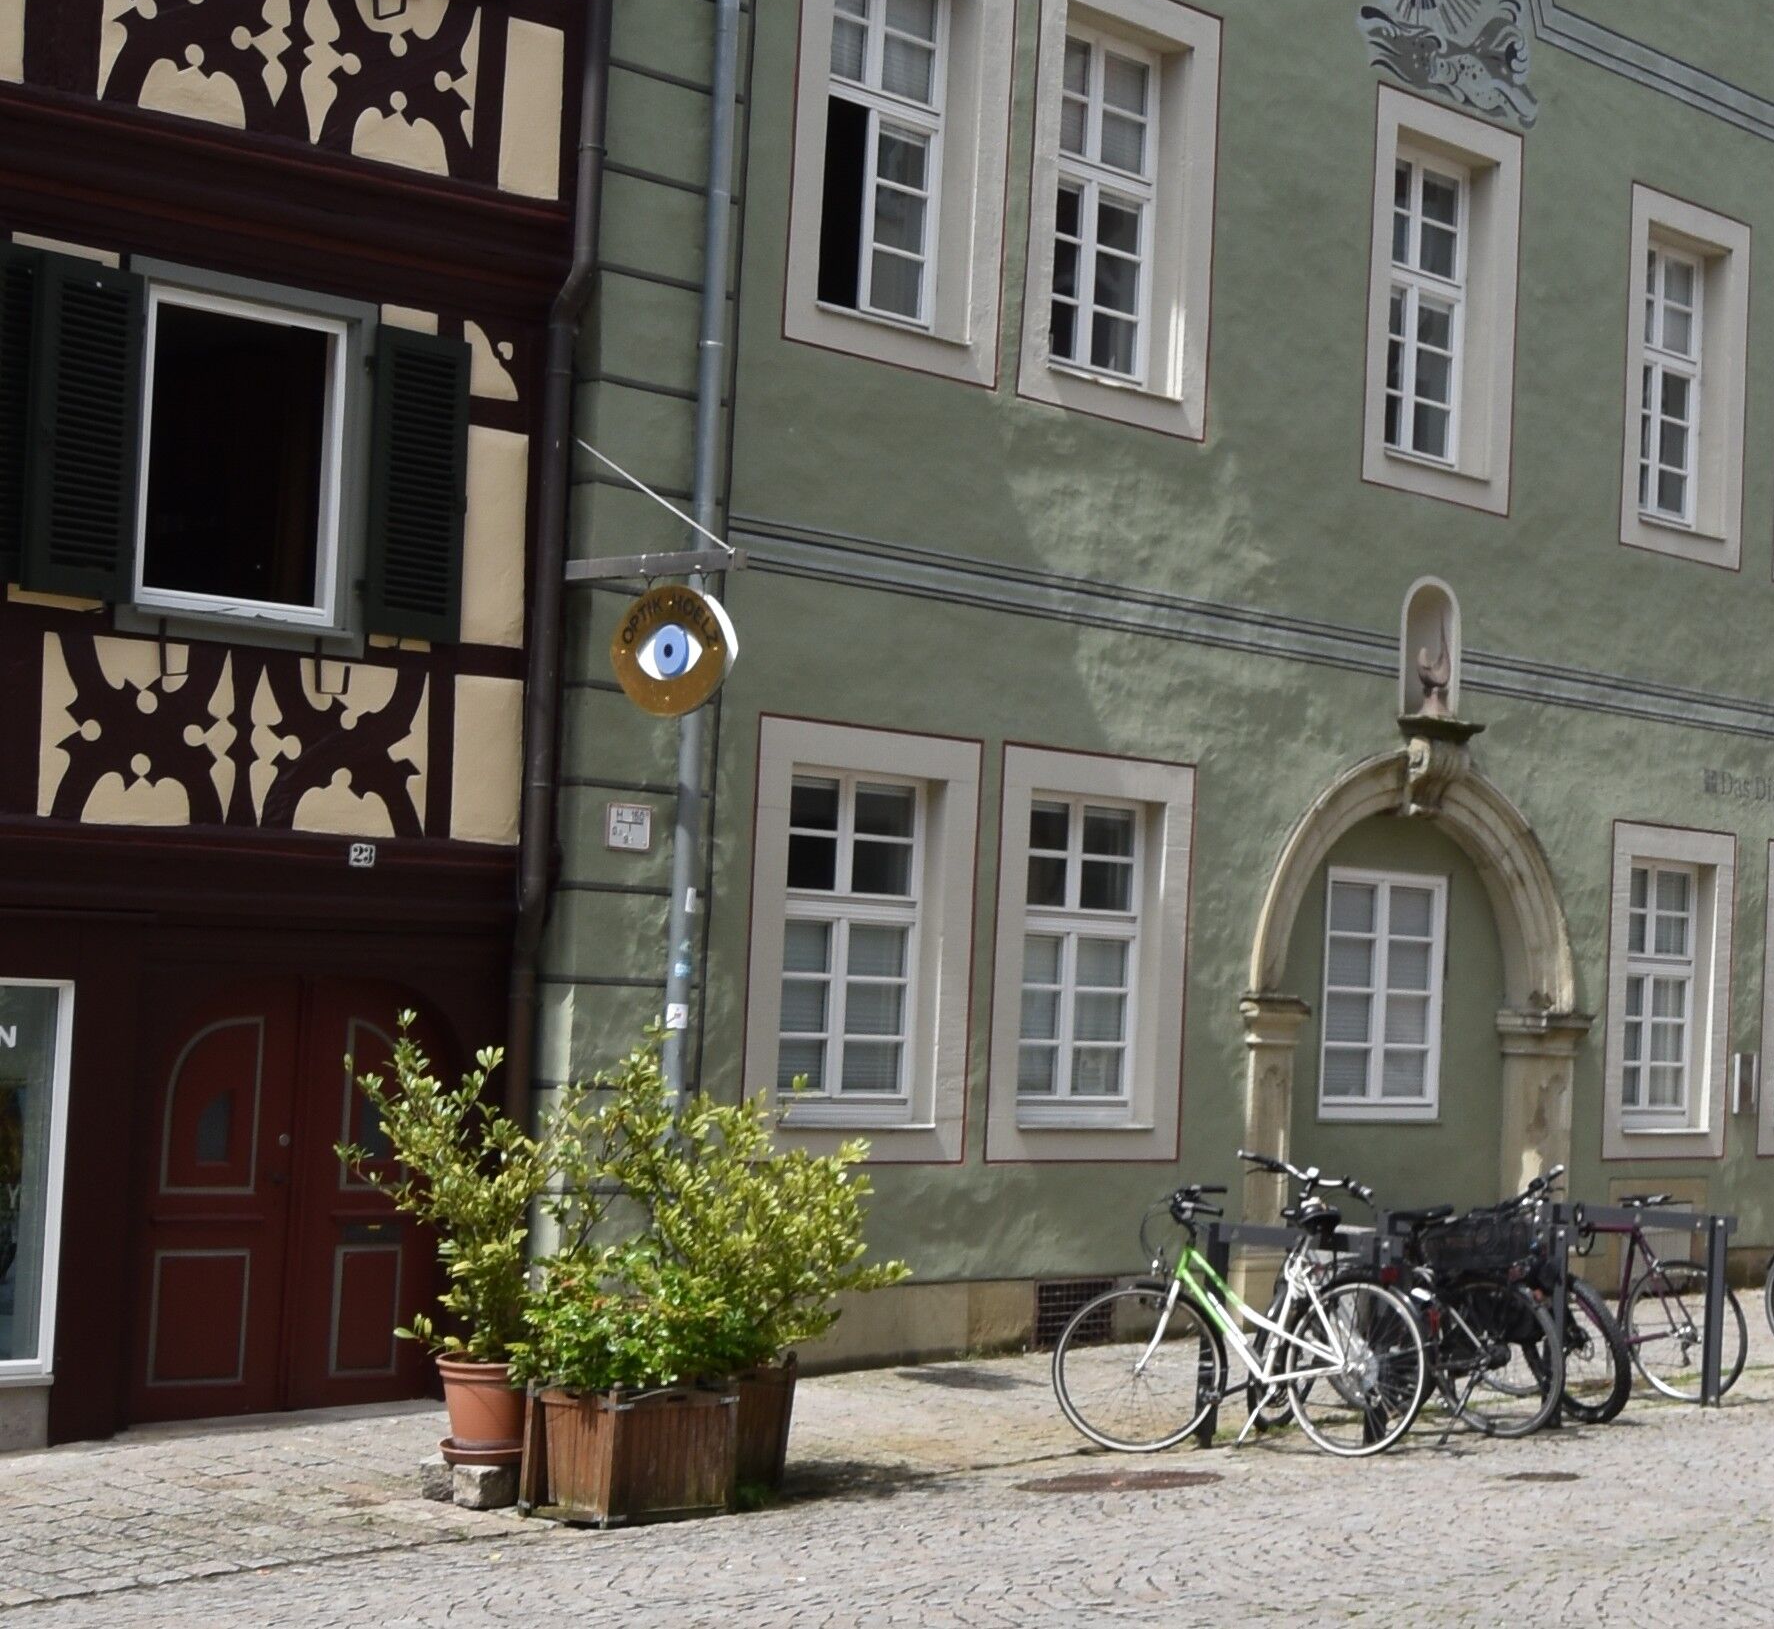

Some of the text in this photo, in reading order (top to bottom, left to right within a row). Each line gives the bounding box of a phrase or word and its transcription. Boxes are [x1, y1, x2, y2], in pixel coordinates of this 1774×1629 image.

[622, 594, 718, 647] OPTIK HOELZ
[1721, 771, 1750, 799] Das
[352, 844, 375, 866] 23
